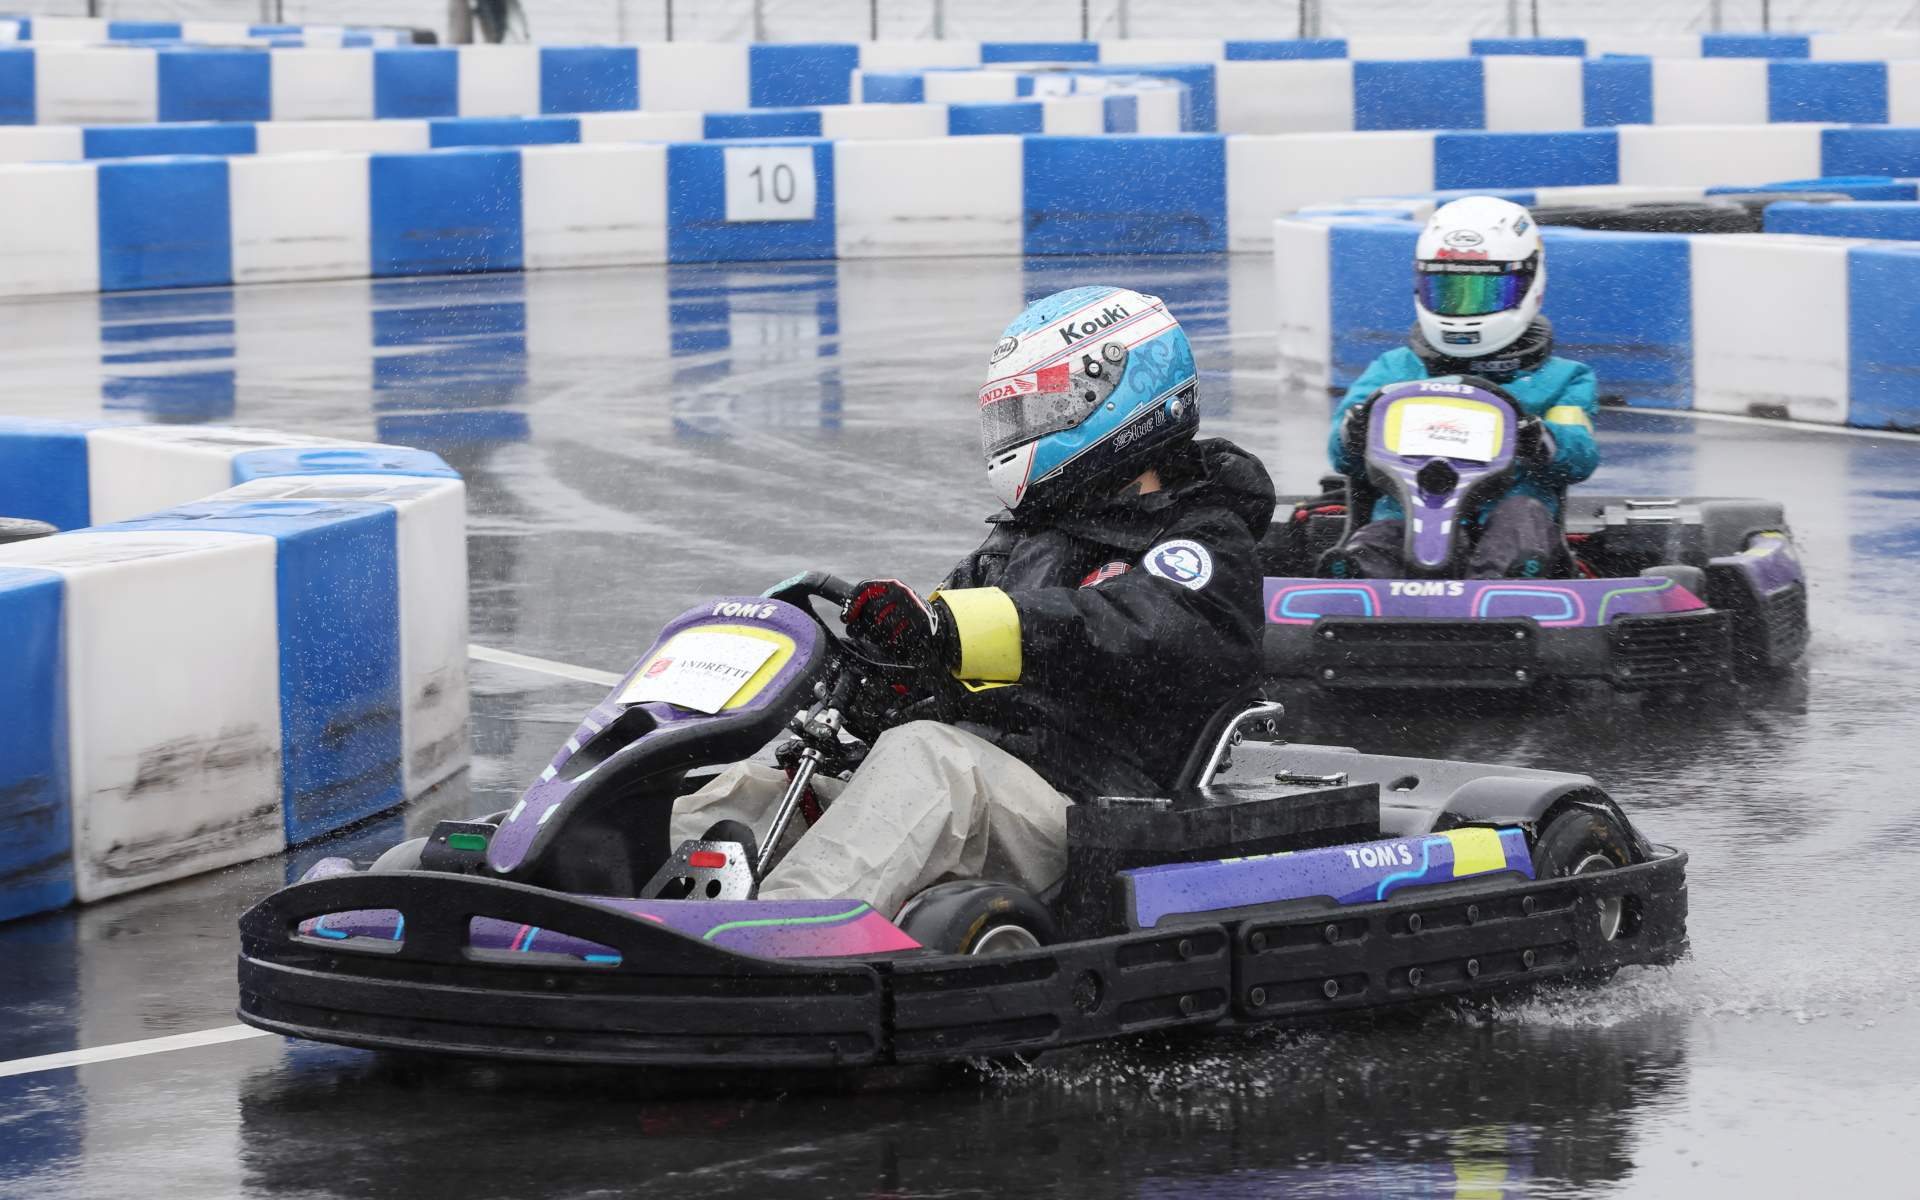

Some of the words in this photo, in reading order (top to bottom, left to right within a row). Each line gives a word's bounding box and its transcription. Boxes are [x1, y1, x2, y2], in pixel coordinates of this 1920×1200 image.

[748, 163, 796, 204] 10
[1058, 303, 1131, 346] Kouki
[1419, 381, 1475, 395] TOM'S
[1112, 417, 1154, 454] Blue
[1389, 580, 1465, 597] TOM'S
[711, 602, 778, 620] TOM'S
[677, 660, 752, 679] ANDRETTI
[1344, 843, 1413, 869] TOM'S
